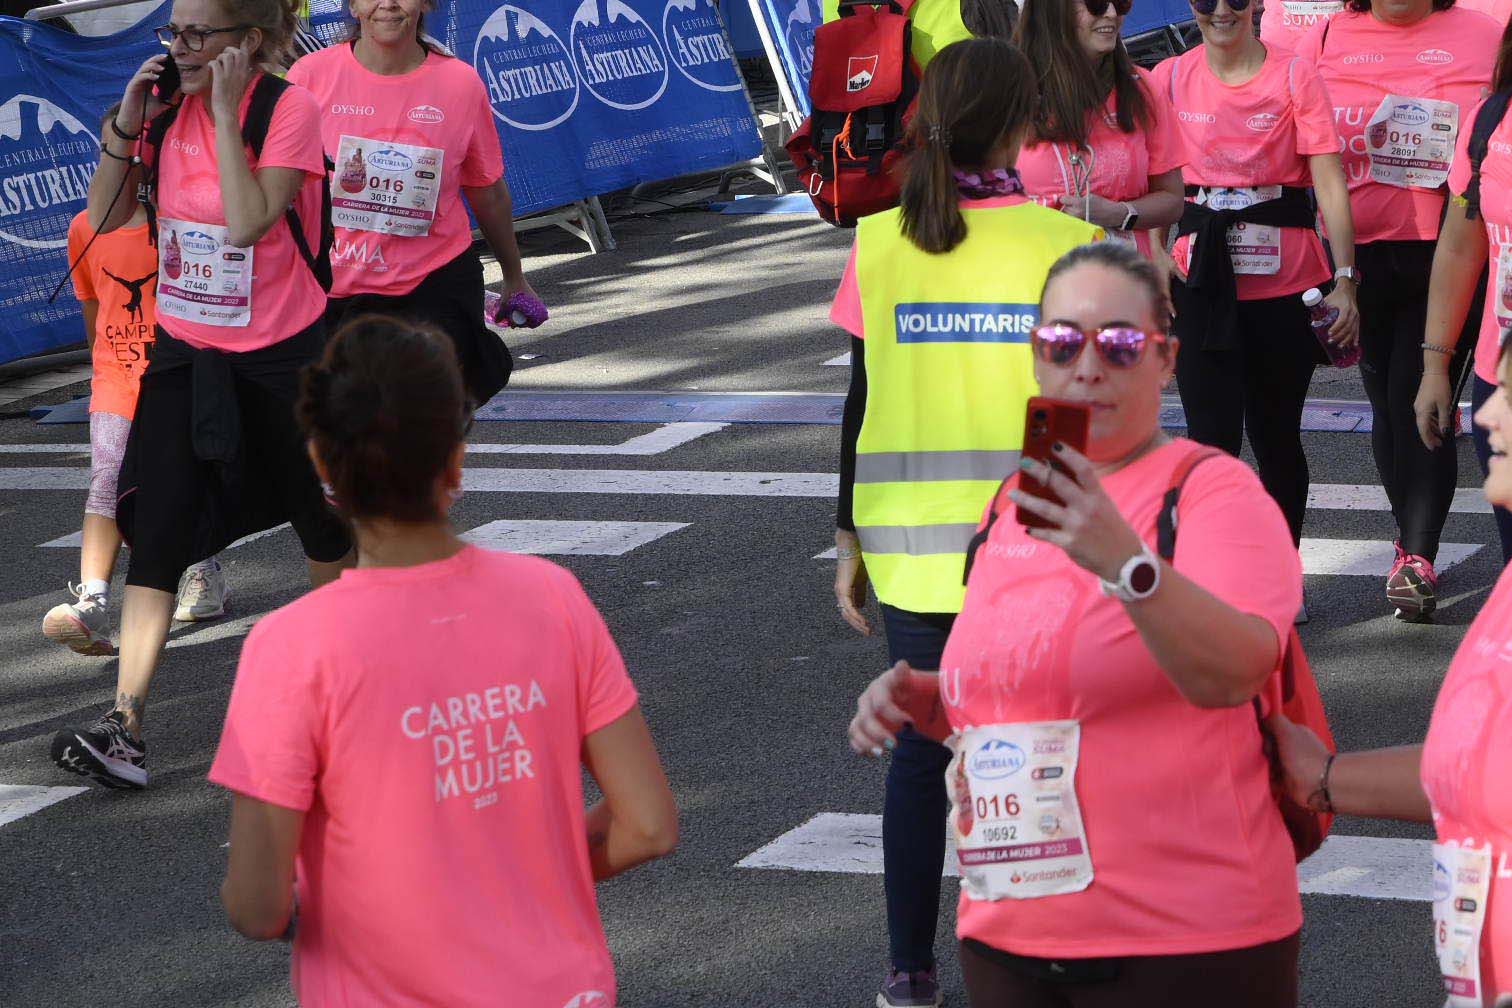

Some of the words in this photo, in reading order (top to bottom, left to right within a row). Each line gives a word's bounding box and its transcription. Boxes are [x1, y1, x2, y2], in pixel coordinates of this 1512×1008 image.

[672, 25, 731, 67] ASTUR
[579, 41, 664, 85] ASTURIANA
[1343, 53, 1384, 65] OYSHO
[483, 57, 575, 104] ASTURIANA
[331, 104, 375, 116] OYSHO
[1332, 106, 1364, 126] TU
[1389, 131, 1422, 146] 016
[1391, 147, 1417, 157] 28091
[369, 176, 404, 193] 016
[342, 199, 370, 210] CARRERA
[370, 192, 398, 204] 30315
[337, 212, 370, 224] OYSHO
[331, 239, 385, 264] UMA
[183, 261, 213, 278] 016
[184, 279, 208, 292] 27440
[105, 324, 155, 340] CAMPU
[898, 312, 1035, 335] VOLUNTARIS
[401, 678, 548, 740] CARRERA
[433, 730, 480, 768] DE
[486, 718, 525, 760] LA
[433, 749, 534, 803] MUJER
[976, 793, 1021, 820] 016
[982, 826, 1018, 843] 10692
[1022, 868, 1078, 883] Santander
